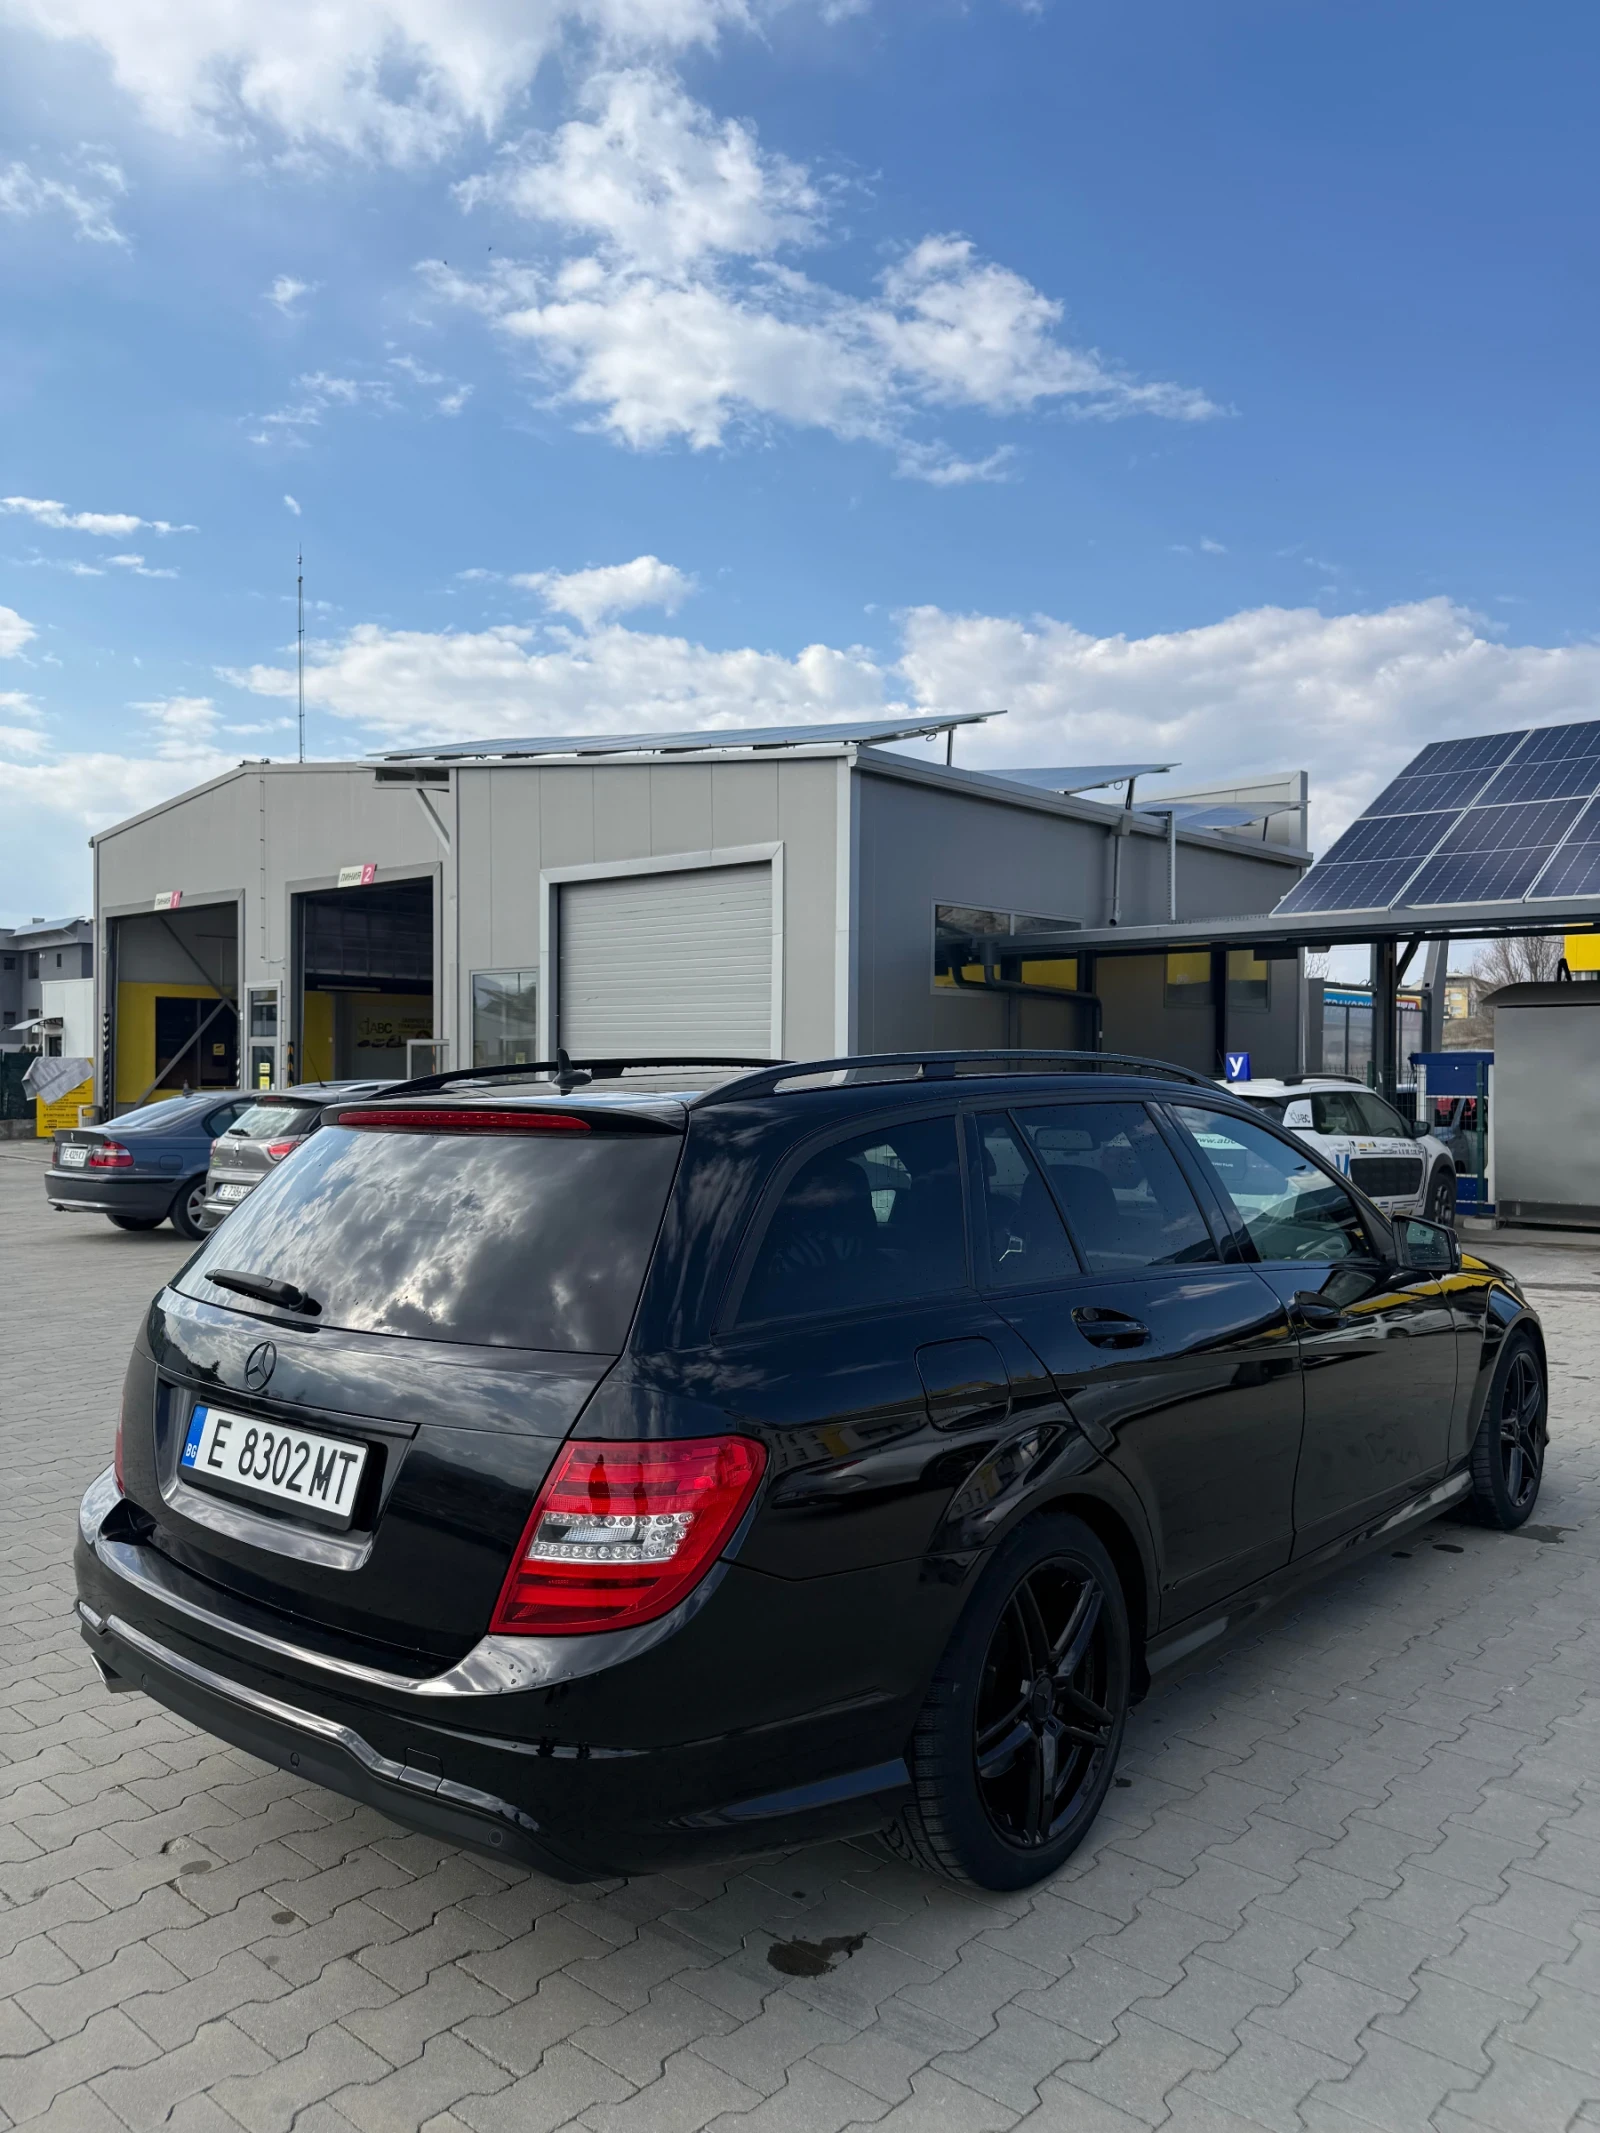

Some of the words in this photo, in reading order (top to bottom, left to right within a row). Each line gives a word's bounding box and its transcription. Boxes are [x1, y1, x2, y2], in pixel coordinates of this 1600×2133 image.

[363, 867, 372, 882] 2
[221, 1185, 228, 1197] E
[185, 1443, 198, 1458] BG
